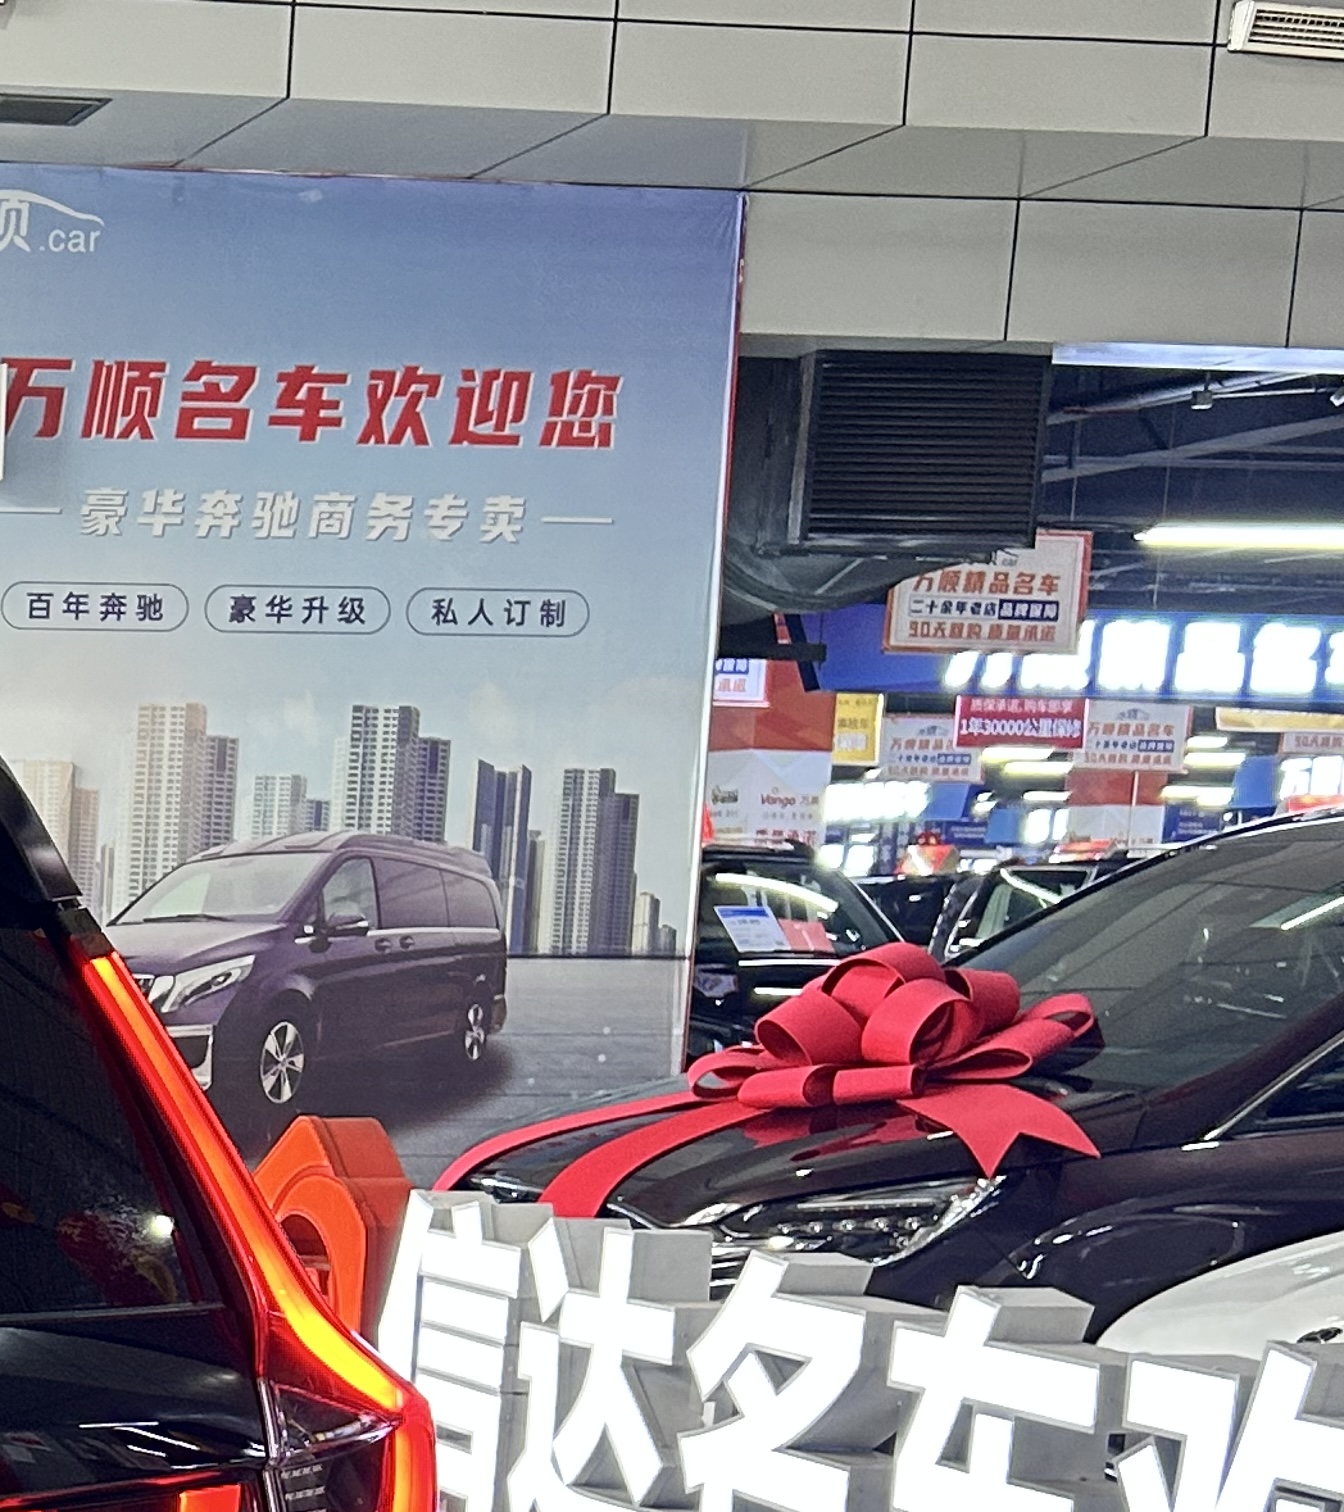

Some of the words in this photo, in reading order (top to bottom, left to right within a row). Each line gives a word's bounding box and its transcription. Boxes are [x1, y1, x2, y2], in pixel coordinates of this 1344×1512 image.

[1, 357, 624, 449] 万顺名车欢迎您
[78, 488, 527, 544] 豪华奔驰商务专卖
[912, 569, 1061, 596] 万顺精品名车
[26, 593, 164, 622] 百年奔驰
[228, 594, 367, 627] 豪华升级
[430, 598, 567, 630] 私人订制
